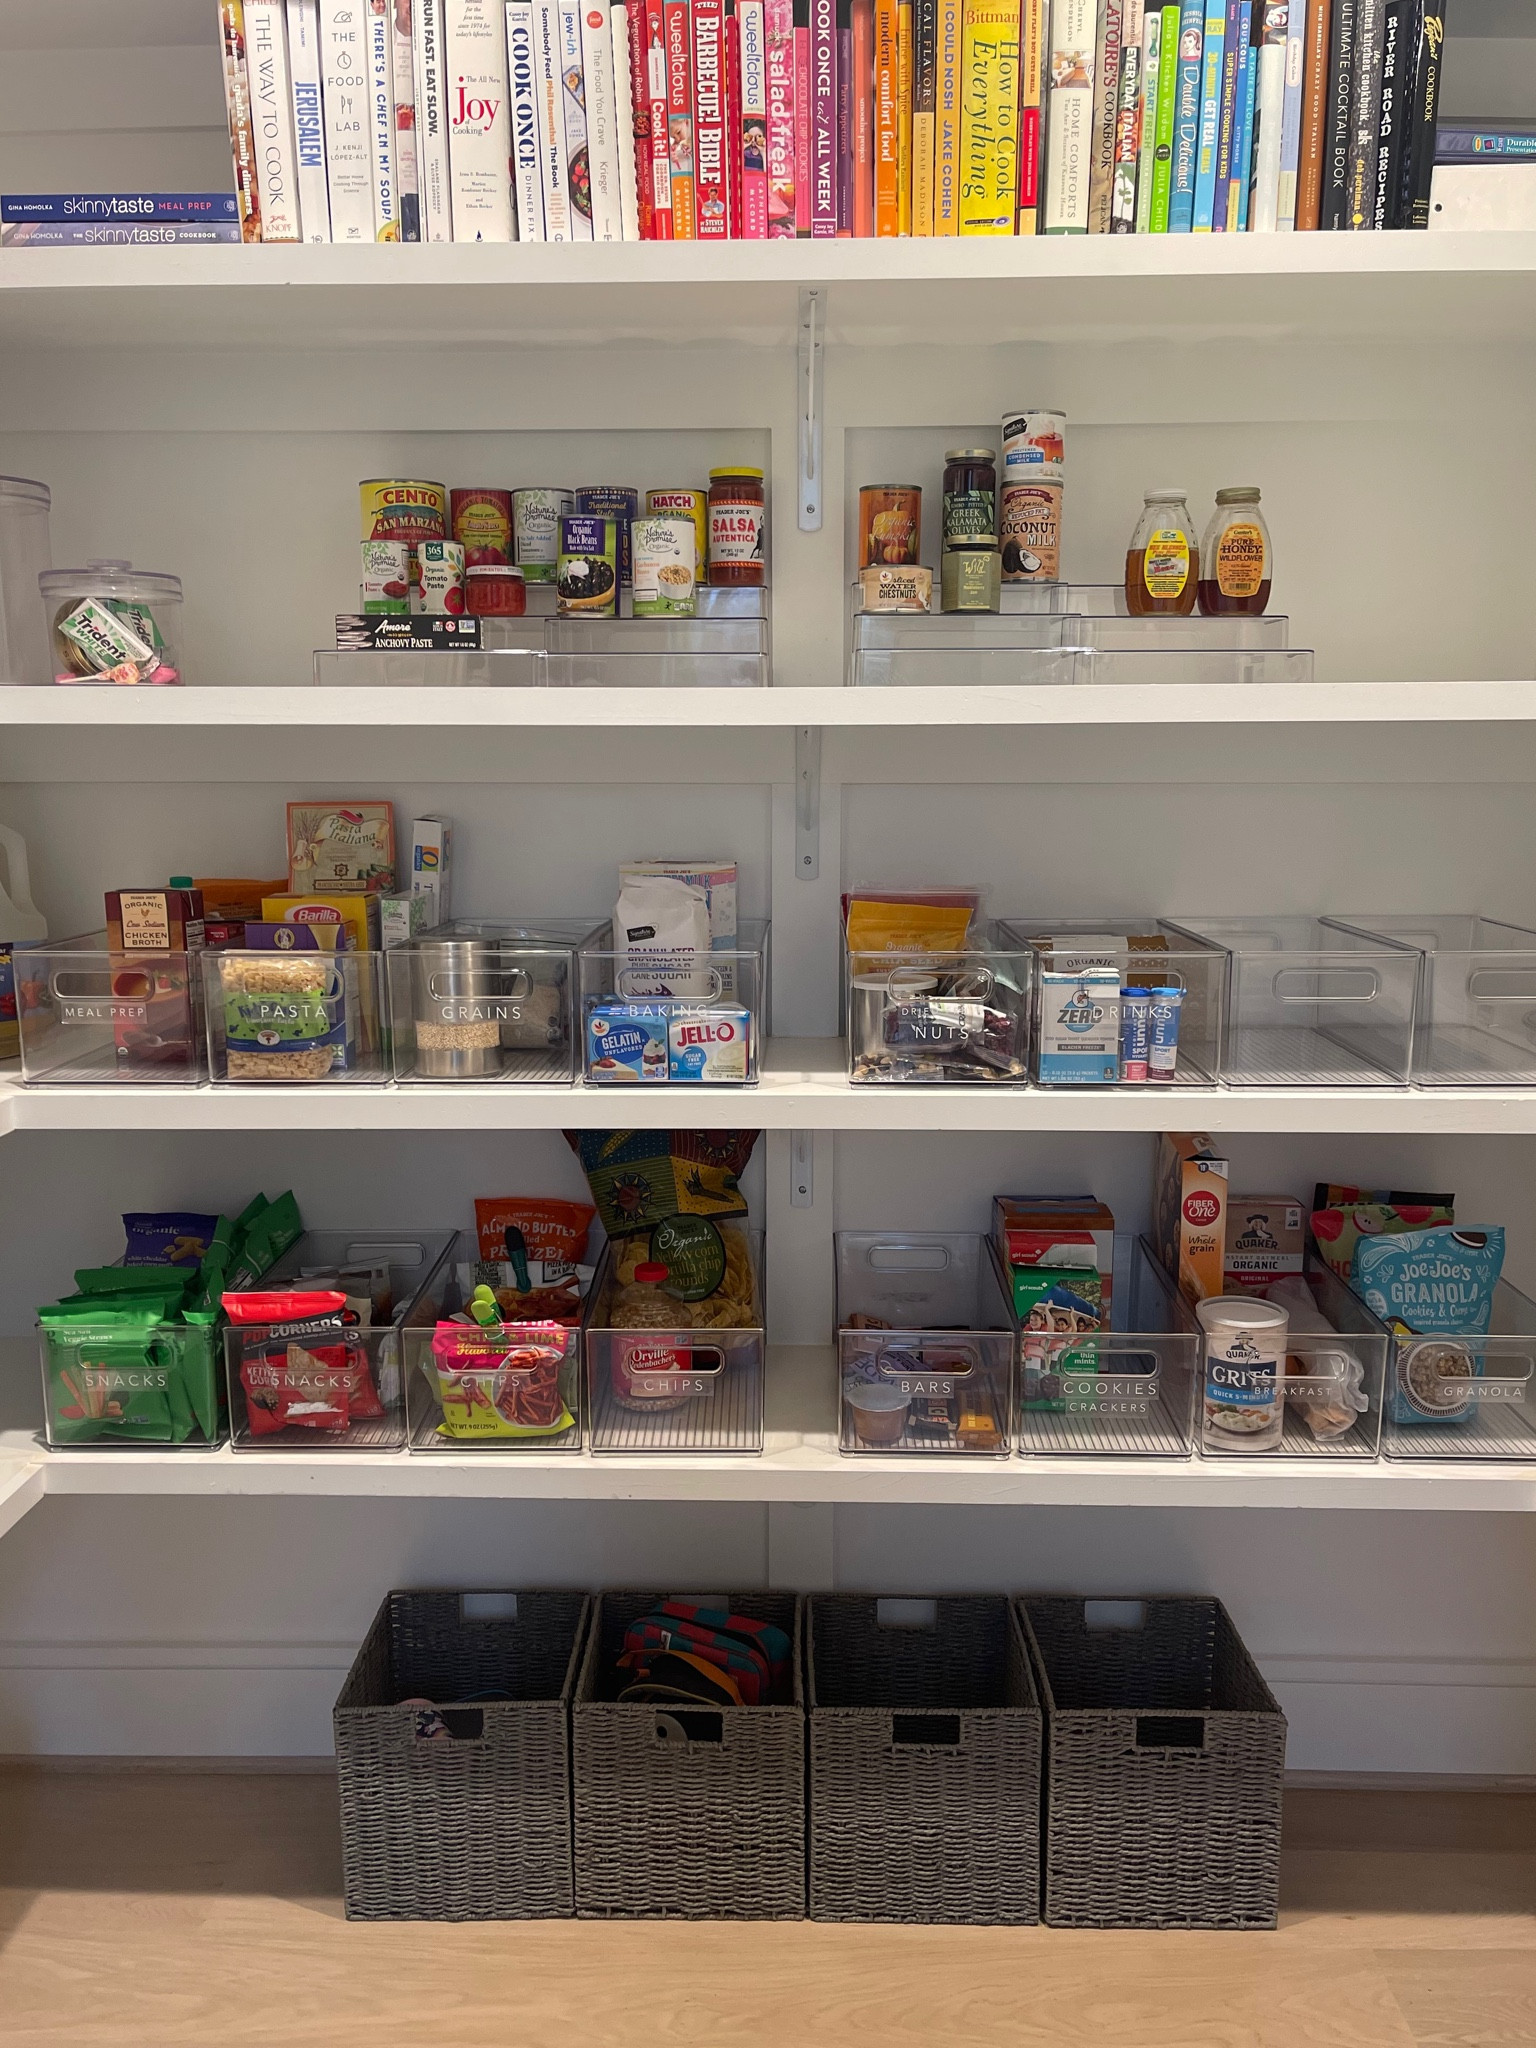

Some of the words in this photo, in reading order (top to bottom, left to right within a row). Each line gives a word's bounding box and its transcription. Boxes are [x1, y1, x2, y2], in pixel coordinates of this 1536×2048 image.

[966, 9, 1019, 25] Bittman
[256, 15, 272, 52] THE
[332, 32, 356, 42] THE
[563, 12, 577, 56] jew-ish
[881, 12, 893, 66] modern
[1340, 3, 1353, 68] ULTIMATE
[374, 21, 385, 73] THERE'S
[1240, 18, 1248, 69] COUSCOUS
[1384, 16, 1398, 78] RIVER
[512, 28, 532, 98] COOK
[593, 49, 602, 67] The
[670, 10, 688, 106] weelicious
[746, 10, 763, 105] weelicious
[1226, 53, 1234, 77] SUPER
[696, 17, 721, 123] BARBECUE!
[817, 47, 830, 96] ONCE
[998, 40, 1019, 96] How
[258, 58, 276, 106] WAY
[328, 77, 364, 86] FOOD
[595, 70, 604, 94] Food
[771, 51, 789, 118] salad
[1125, 48, 1137, 110] EVERYDAY
[881, 71, 894, 124] comfort
[1225, 79, 1233, 106] SIMPLE
[1424, 66, 1436, 122] COOKBOOK
[377, 94, 387, 127] CHEF
[453, 86, 501, 131] Joy
[596, 97, 604, 114] You
[816, 102, 829, 124] eat
[1204, 100, 1217, 123] GET
[1335, 74, 1350, 142] COCKTAIL
[1381, 88, 1393, 137] ROAD
[295, 81, 322, 167] JERUSALEM
[962, 38, 997, 199] Everything
[998, 105, 1013, 127] to
[1071, 98, 1081, 137] HOME
[262, 111, 279, 139] TO
[336, 122, 361, 131] LAB
[452, 127, 483, 136] Cooking
[597, 118, 607, 145] Crave
[1101, 92, 1115, 169] COOKBOOK
[1221, 110, 1231, 143] COOKING
[378, 133, 388, 148] IN
[516, 103, 536, 169] ONCE
[818, 128, 830, 158] ALL
[1121, 111, 1134, 161] ITALIAN
[1202, 124, 1215, 147] REAL
[882, 131, 894, 162] food
[1220, 146, 1228, 160] FOR
[698, 127, 721, 184] BIBLE
[771, 123, 792, 193] freak
[379, 155, 389, 174] MY
[996, 137, 1015, 200] Cook
[1219, 162, 1227, 179] KIDS
[1333, 148, 1346, 188] BOOK
[264, 146, 284, 206] COOK
[598, 161, 608, 195] Krieger
[1068, 145, 1080, 218] COMFORTS
[525, 176, 533, 212] DINNER
[818, 163, 831, 212] WEEK
[1374, 146, 1389, 230] RECIPES
[63, 197, 154, 217] skinnytaste
[158, 202, 184, 210] MEAL
[188, 202, 212, 210] PREP
[381, 180, 392, 221] SOUP!
[1155, 200, 1164, 231] CHILD
[266, 224, 292, 233] KNOPF
[383, 490, 437, 507] CENTO
[588, 502, 626, 510] Traditional
[652, 496, 691, 508] HATCH
[1011, 499, 1044, 509] Organic
[525, 503, 557, 515] Nature's
[953, 509, 980, 517] GREEK
[377, 519, 396, 533] SAN
[398, 517, 444, 535] MARZANO
[572, 525, 593, 535] Organic
[712, 518, 755, 532] SALSA
[946, 518, 987, 527] KALAMATA
[952, 526, 981, 534] OLIVES
[1001, 522, 1056, 536] COCONUT
[568, 535, 582, 544] Black
[582, 535, 597, 545] Beans
[646, 528, 674, 539] Nature's
[713, 534, 755, 543] AUTENTICA
[1027, 535, 1056, 547] MILK
[427, 547, 441, 556] 365
[1222, 546, 1260, 554] HONEY
[426, 566, 444, 574] Organic
[879, 590, 917, 599] CHESTNUTS
[375, 619, 411, 634] Amore
[75, 614, 126, 660] Trident
[76, 628, 108, 656] WHITE
[375, 638, 409, 648] ANCHOVY
[411, 638, 433, 648] PASTE
[329, 818, 362, 834] Pasta
[329, 830, 377, 845] Italiana
[124, 901, 163, 909] ORGANIC
[298, 909, 337, 921] Barilla
[1067, 958, 1115, 968] ORGANIC
[65, 1008, 102, 1017] MEAL
[110, 1008, 144, 1017] PREP
[261, 1006, 327, 1018] PASTA
[442, 1007, 521, 1020] GRAINS
[629, 1005, 708, 1017] BAKING
[1093, 1006, 1172, 1019] DRINKS
[601, 1032, 643, 1050] GELATIN
[915, 1027, 969, 1039] NUTS
[604, 1045, 643, 1056] UNFLAVORED
[1187, 1200, 1214, 1208] FIBER
[1188, 1206, 1216, 1218] One
[533, 1223, 576, 1237] BUTTER
[658, 1229, 712, 1255] Organic
[1188, 1236, 1216, 1245] Whole
[1235, 1239, 1278, 1251] QUAKER
[694, 1245, 718, 1257] corn
[1189, 1245, 1215, 1256] grain
[699, 1257, 721, 1273] chip
[1233, 1261, 1279, 1270] ORGANIC
[1399, 1261, 1472, 1283] Joe-Joe's
[1391, 1283, 1478, 1304] GRANOLA
[269, 1315, 342, 1338] CORNERS
[525, 1332, 564, 1344] LIME
[632, 1348, 669, 1362] Orville
[85, 1374, 166, 1387] SNACKS
[271, 1375, 352, 1388] SNACKS
[460, 1375, 520, 1387] CHIPS
[1212, 1365, 1271, 1387] GRITS
[643, 1379, 704, 1391] CHIPS
[901, 1381, 951, 1394] BARS
[1063, 1382, 1157, 1395] COOKIES
[1213, 1389, 1233, 1398] QUICK
[1254, 1386, 1332, 1396] BREAKFAST
[1443, 1386, 1522, 1397] GRANOLA
[1069, 1403, 1147, 1413] CRACKERS
